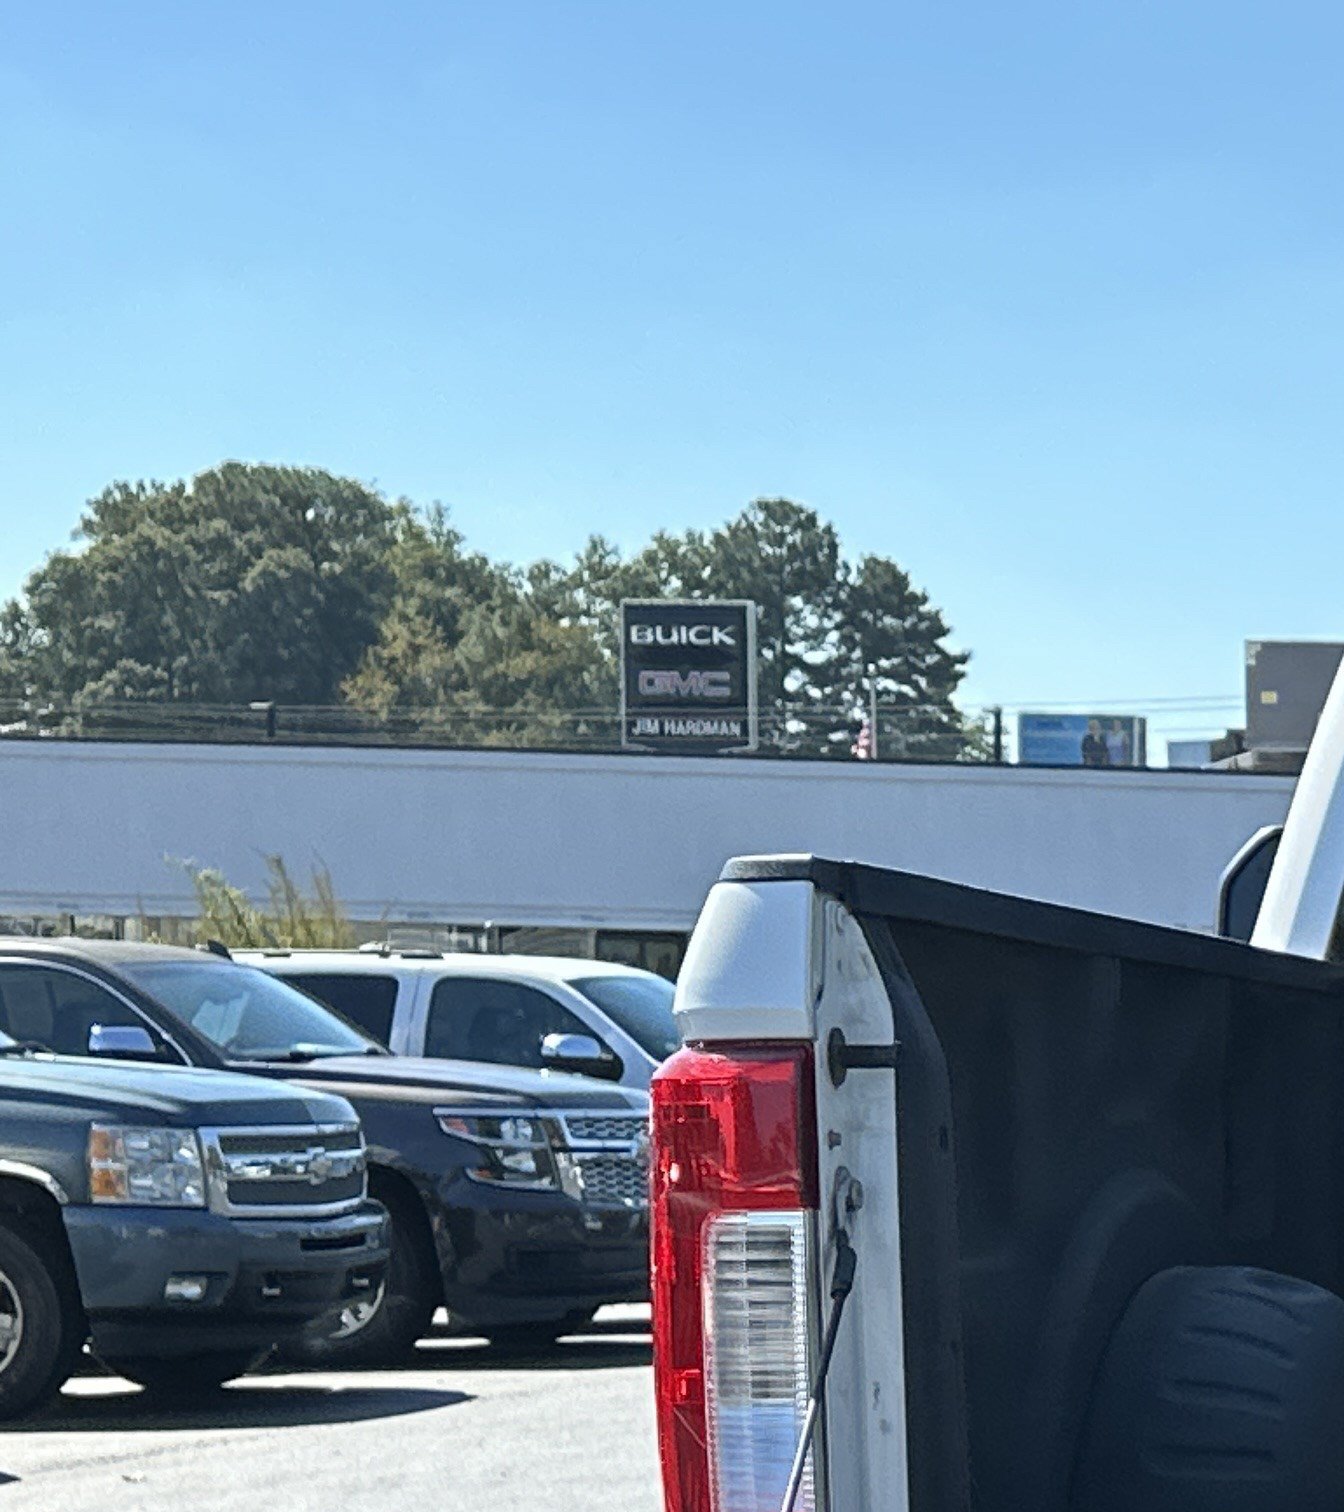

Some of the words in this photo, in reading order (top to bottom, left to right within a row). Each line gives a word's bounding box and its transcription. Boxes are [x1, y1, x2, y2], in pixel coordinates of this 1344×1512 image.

[630, 624, 736, 646] BUICK
[639, 670, 731, 697] GMC
[631, 719, 657, 736] JIM
[664, 719, 741, 738] HARDMAN
